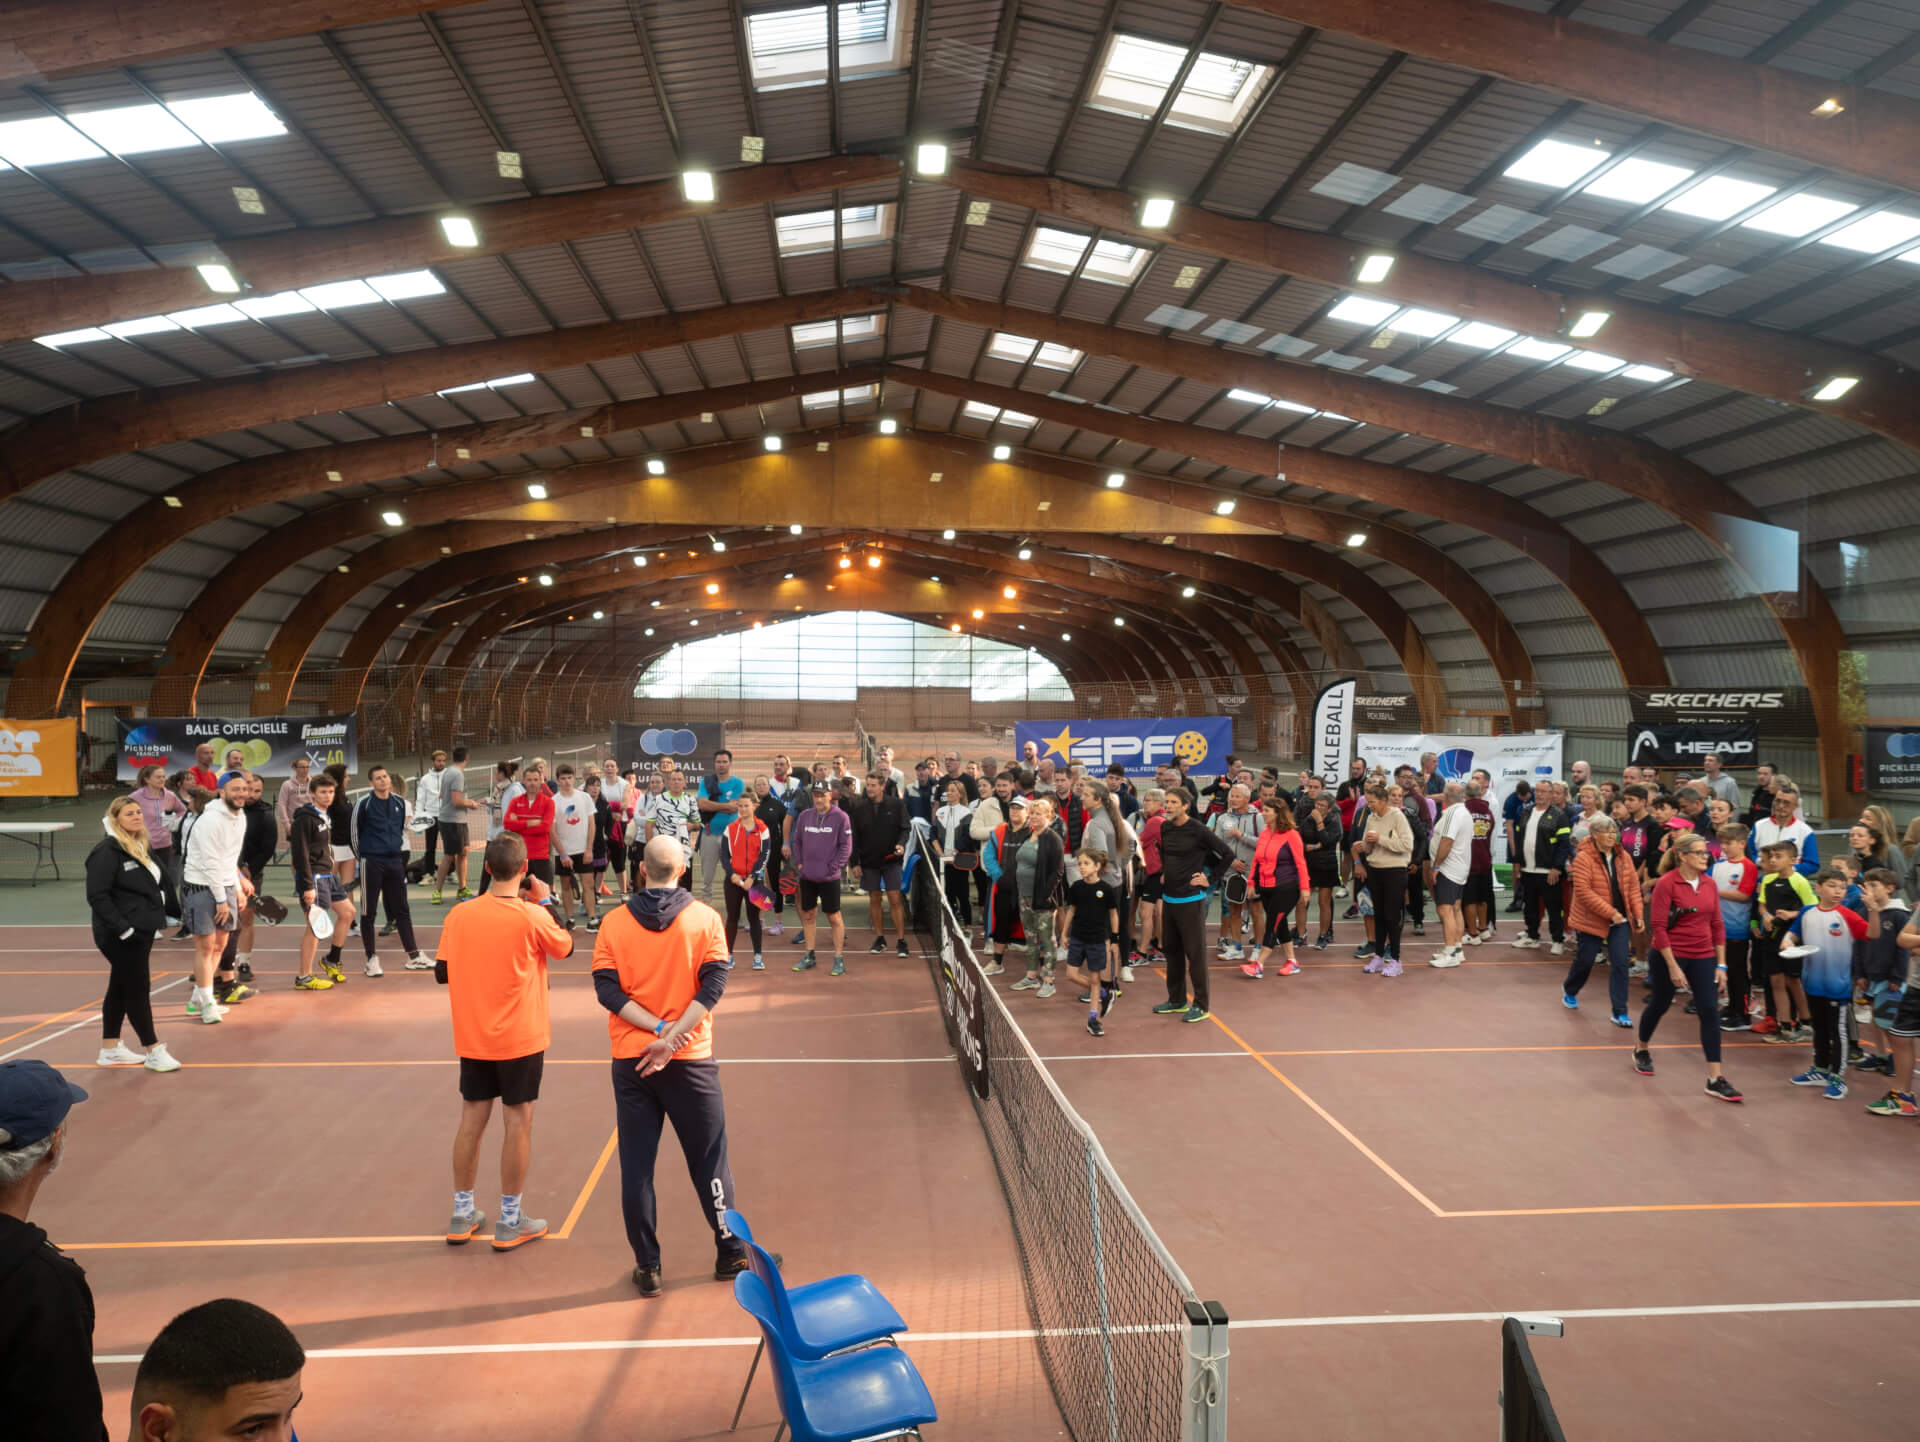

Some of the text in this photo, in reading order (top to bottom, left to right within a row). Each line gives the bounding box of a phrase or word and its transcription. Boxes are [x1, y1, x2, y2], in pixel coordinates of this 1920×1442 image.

[1354, 697, 1407, 706] SKECHERS
[1646, 693, 1783, 708] SKECHERS
[185, 722, 289, 736] BALLE OFFICIELLE
[124, 744, 172, 752] Pickleball
[305, 738, 343, 746] PICKLEBALL
[1674, 741, 1753, 754] HEAD
[1070, 735, 1177, 766] EPF
[305, 750, 344, 768] X-40
[631, 761, 705, 771] PICKBALL
[711, 1178, 732, 1240] HEAD
